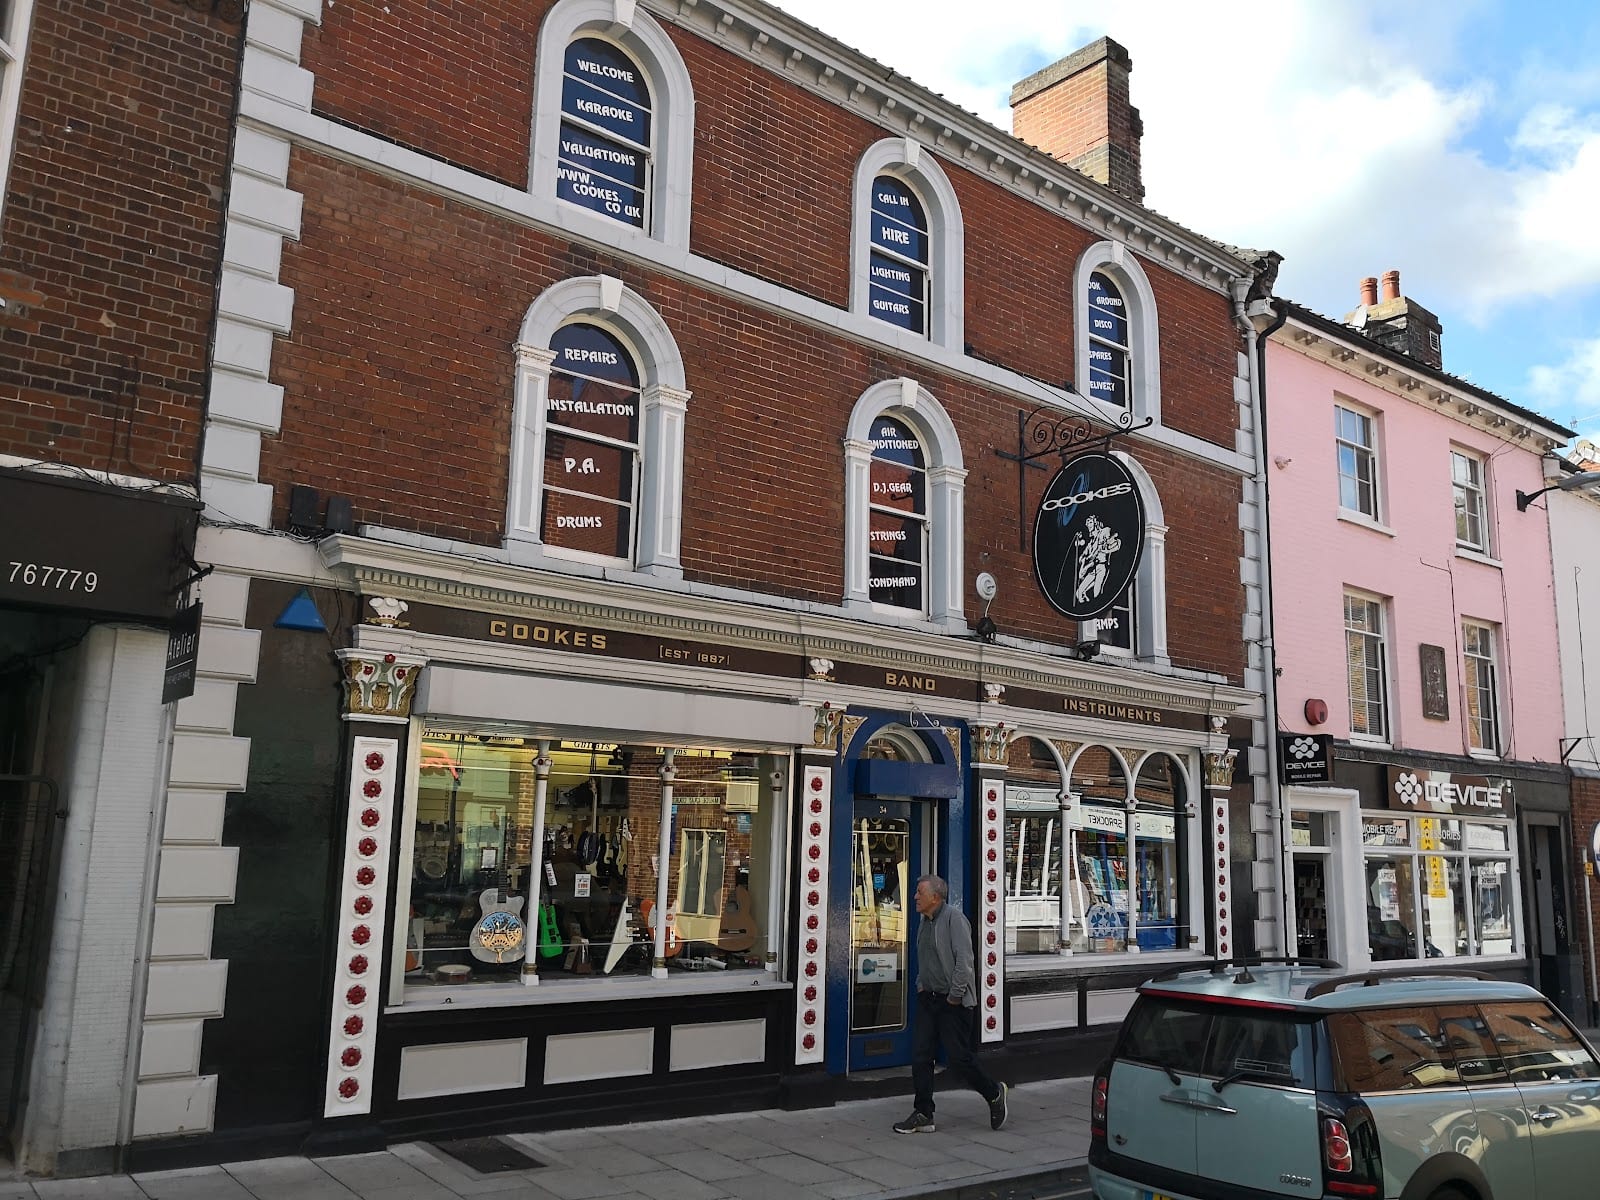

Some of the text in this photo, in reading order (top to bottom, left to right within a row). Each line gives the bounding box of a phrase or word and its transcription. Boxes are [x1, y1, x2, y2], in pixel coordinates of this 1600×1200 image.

[576, 58, 635, 83] WELCOME
[576, 98, 634, 123] KARAOKE
[561, 140, 637, 167] VALUATIONS
[572, 183, 623, 203] COOKES.
[878, 192, 910, 207] CALL IN
[605, 201, 641, 219] CO UK
[881, 226, 910, 245] HIRE
[871, 265, 911, 282] LIGHTING
[1088, 281, 1102, 291] OOK
[872, 299, 910, 315] GUITARS
[1096, 296, 1123, 307] AROUND
[1093, 319, 1113, 330] DISCO
[564, 348, 618, 365] REPAIRS
[1090, 380, 1116, 392] ELIVERY
[547, 399, 635, 417] INSTALLATION
[881, 427, 897, 438] AIR
[869, 439, 919, 450] NDITIONED
[564, 457, 601, 475] P.A.
[1041, 482, 1132, 511] COOKES
[556, 516, 603, 529] DRUMS
[870, 530, 907, 542] STRINGS
[8, 561, 98, 593] 767779
[869, 577, 917, 588] CONDHAND
[489, 620, 607, 649] COOKES
[167, 632, 196, 661] Atelier
[885, 672, 936, 691] BAND
[1063, 698, 1162, 723] INSTRUMENTS
[1285, 760, 1326, 770] DEVICE
[1423, 780, 1502, 808] DEVICE
[1279, 1173, 1312, 1188] COOPER
